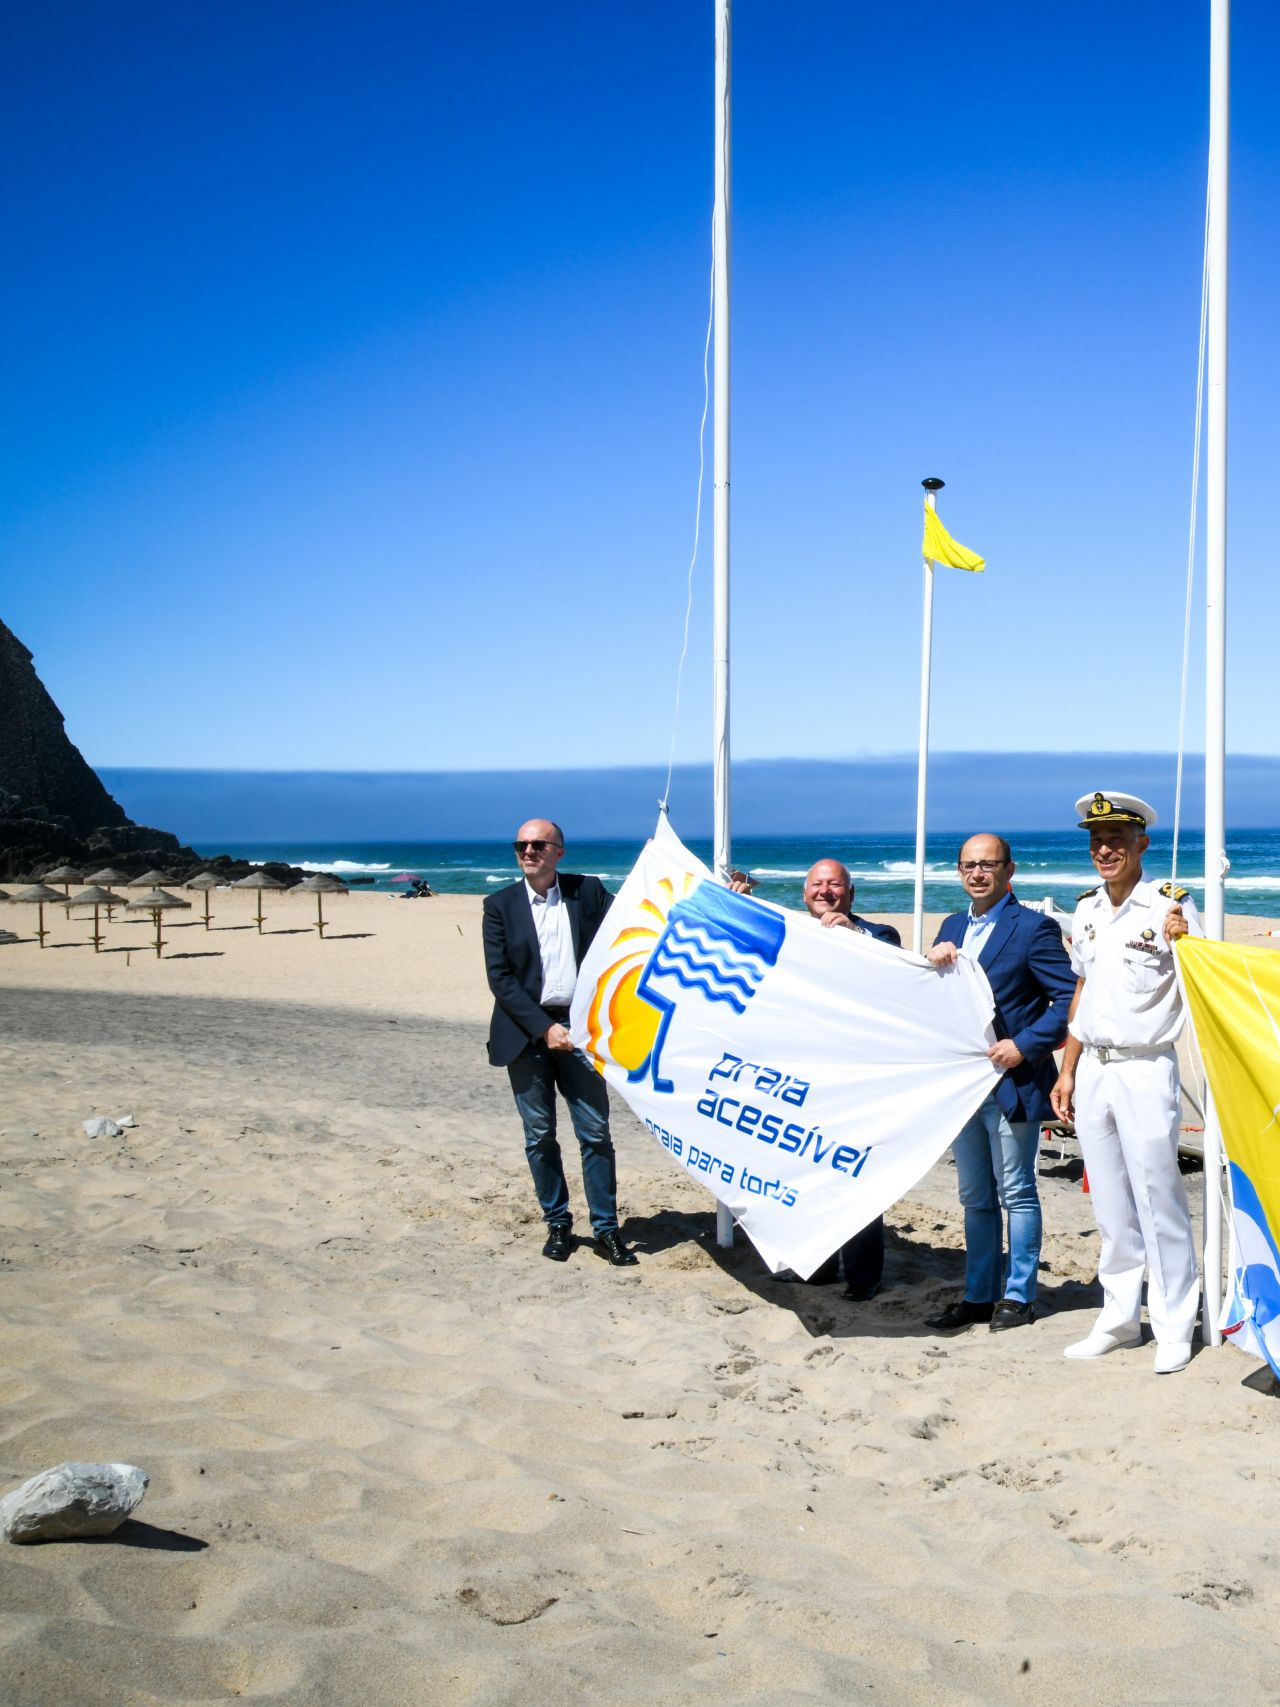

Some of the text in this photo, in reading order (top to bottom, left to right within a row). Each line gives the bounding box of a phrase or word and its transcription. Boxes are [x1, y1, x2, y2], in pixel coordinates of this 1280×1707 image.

[708, 1052, 811, 1107] praia
[697, 1088, 872, 1178] acessível
[687, 1145, 735, 1184] para
